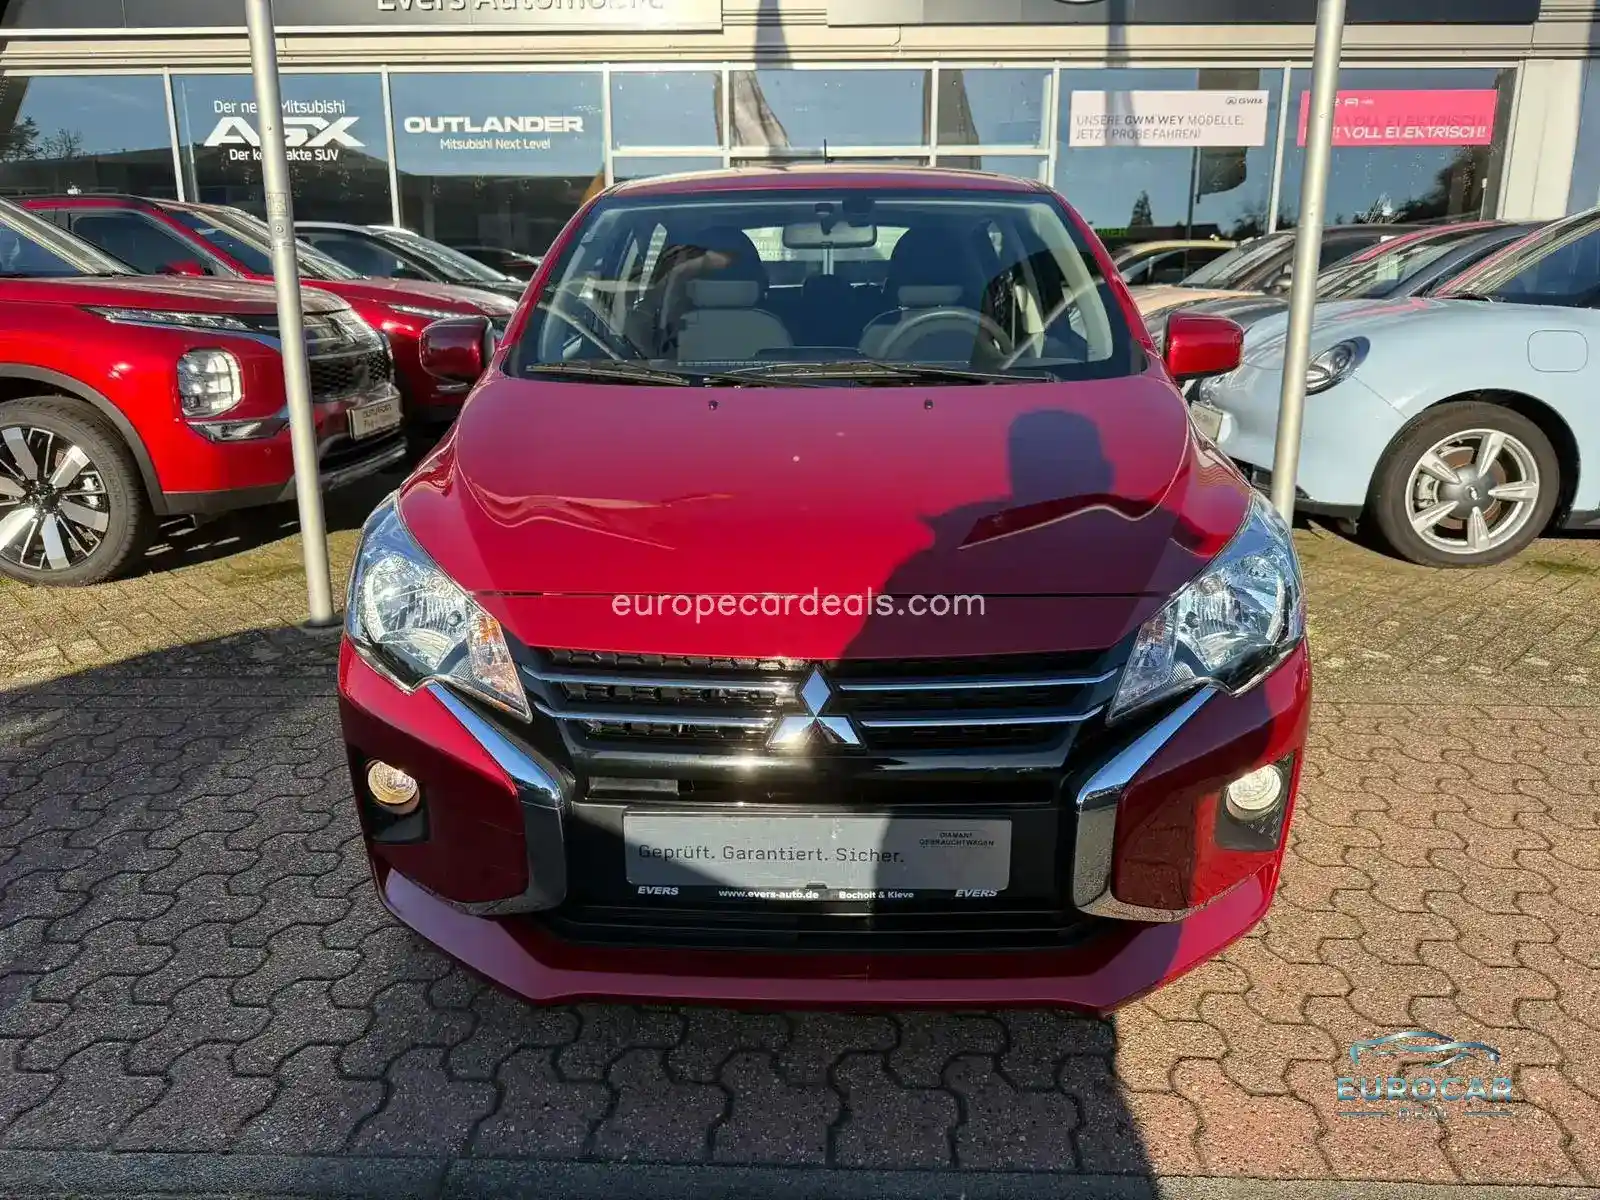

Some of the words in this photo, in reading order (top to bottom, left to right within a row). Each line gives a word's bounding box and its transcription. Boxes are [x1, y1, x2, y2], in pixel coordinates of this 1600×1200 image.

[214, 101, 236, 113] Der
[282, 100, 346, 113] Mitsubishi
[404, 116, 584, 133] OUTLANDER
[1076, 115, 1120, 125] UNSERE
[1125, 115, 1154, 125] GWM
[1158, 115, 1184, 125] WEY
[203, 116, 366, 147] ASX
[1076, 128, 1108, 139] JETZT
[1112, 128, 1151, 139] PROBE
[1344, 126, 1381, 138] VOLL
[440, 139, 492, 150] Mitsubishi
[496, 139, 520, 150] Next
[525, 139, 551, 150] Level
[229, 149, 249, 160] Der
[253, 148, 311, 160] kakte
[316, 149, 338, 160] SUV
[639, 844, 715, 861] Geprüft.
[723, 846, 829, 860] Garantiert.
[836, 848, 904, 862] Sicher.
[638, 886, 679, 895] EVERS
[718, 889, 819, 899] www.evers-auto.de
[839, 891, 876, 899] Bocholt
[955, 889, 998, 897] EVERS
